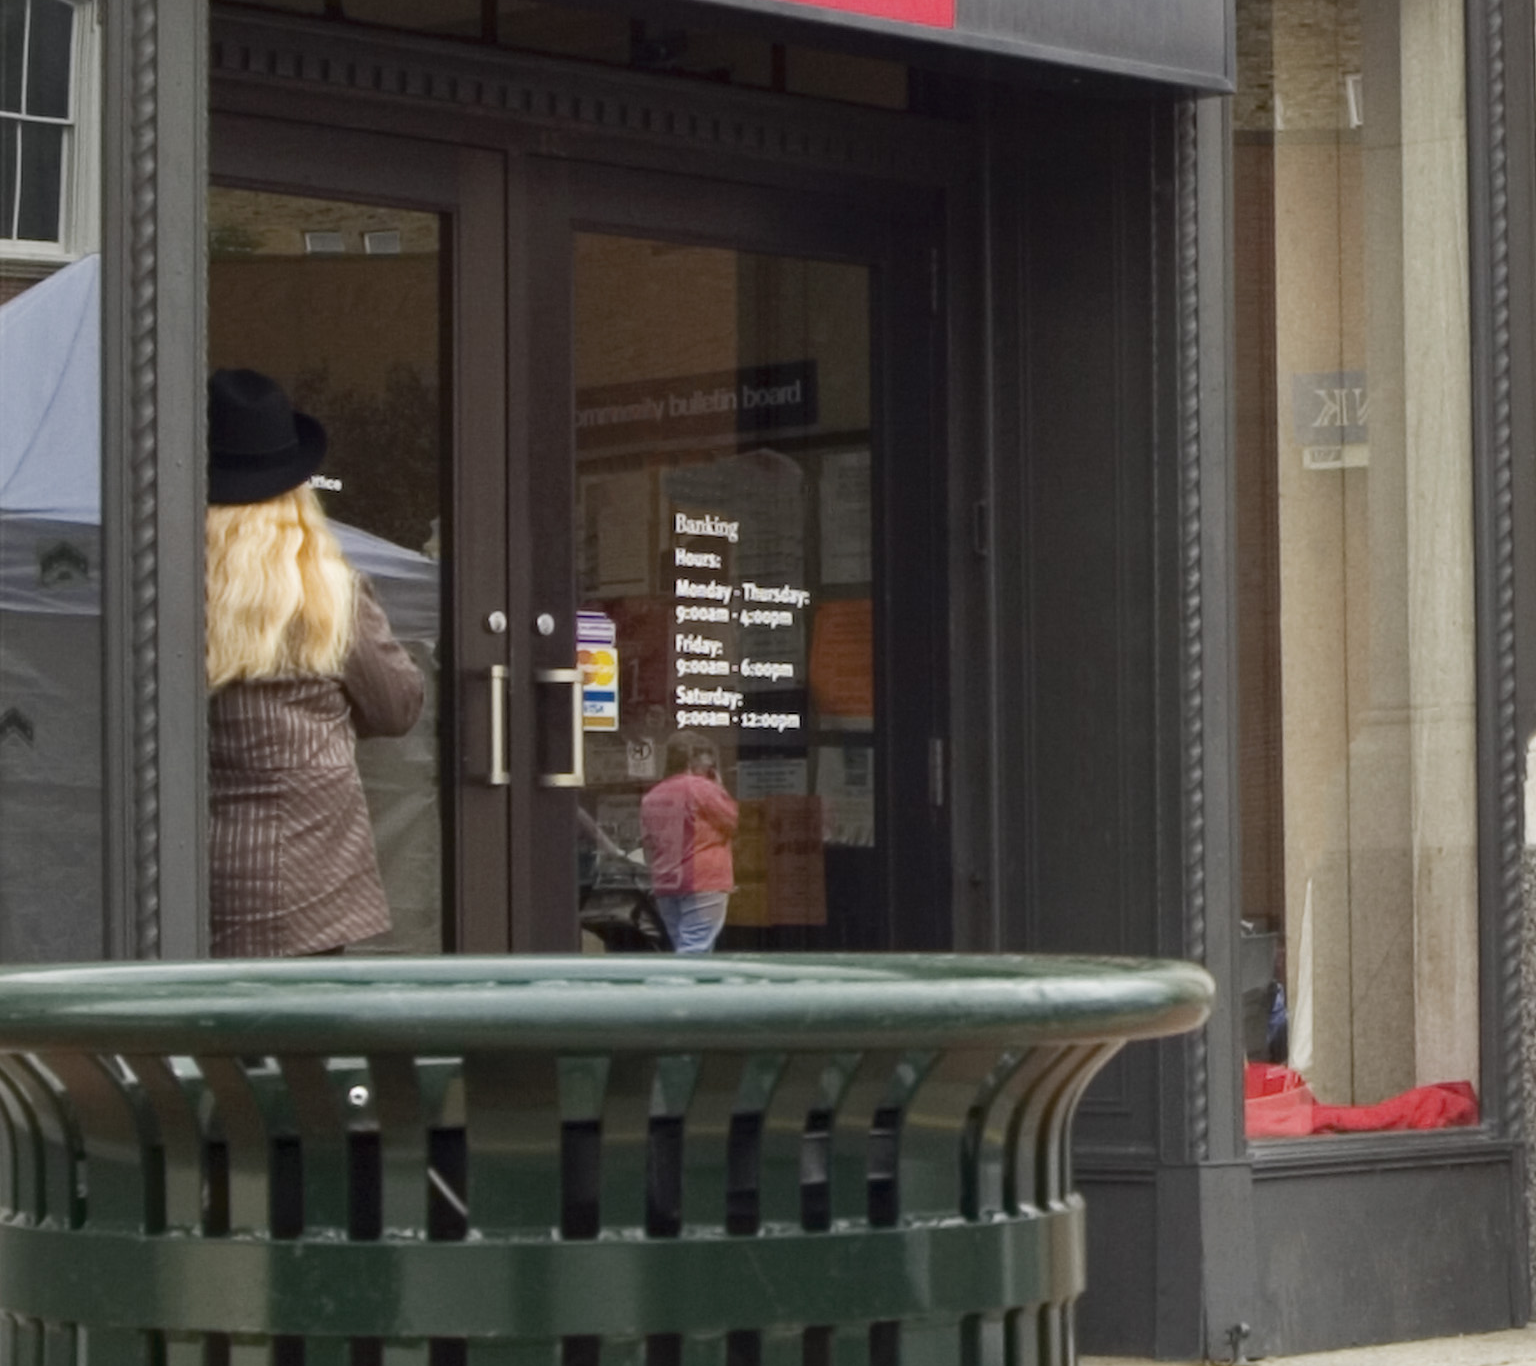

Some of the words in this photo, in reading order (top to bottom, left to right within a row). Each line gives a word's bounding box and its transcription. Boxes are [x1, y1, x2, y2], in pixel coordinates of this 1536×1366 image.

[669, 388, 738, 418] bulletin
[742, 379, 802, 409] board
[675, 512, 740, 543] Banking
[675, 547, 722, 569] Hours:
[674, 578, 733, 605] Monday
[741, 582, 811, 609] Thursday:
[675, 604, 730, 624] 9:00am
[739, 609, 794, 630] 4:00pm
[675, 633, 724, 658] Friday:
[675, 658, 731, 677] 9:00am
[739, 657, 794, 682] 6:00pm
[675, 684, 744, 711] Saturday:
[675, 710, 731, 729] 9:00am
[739, 711, 801, 733] 12:00pm
